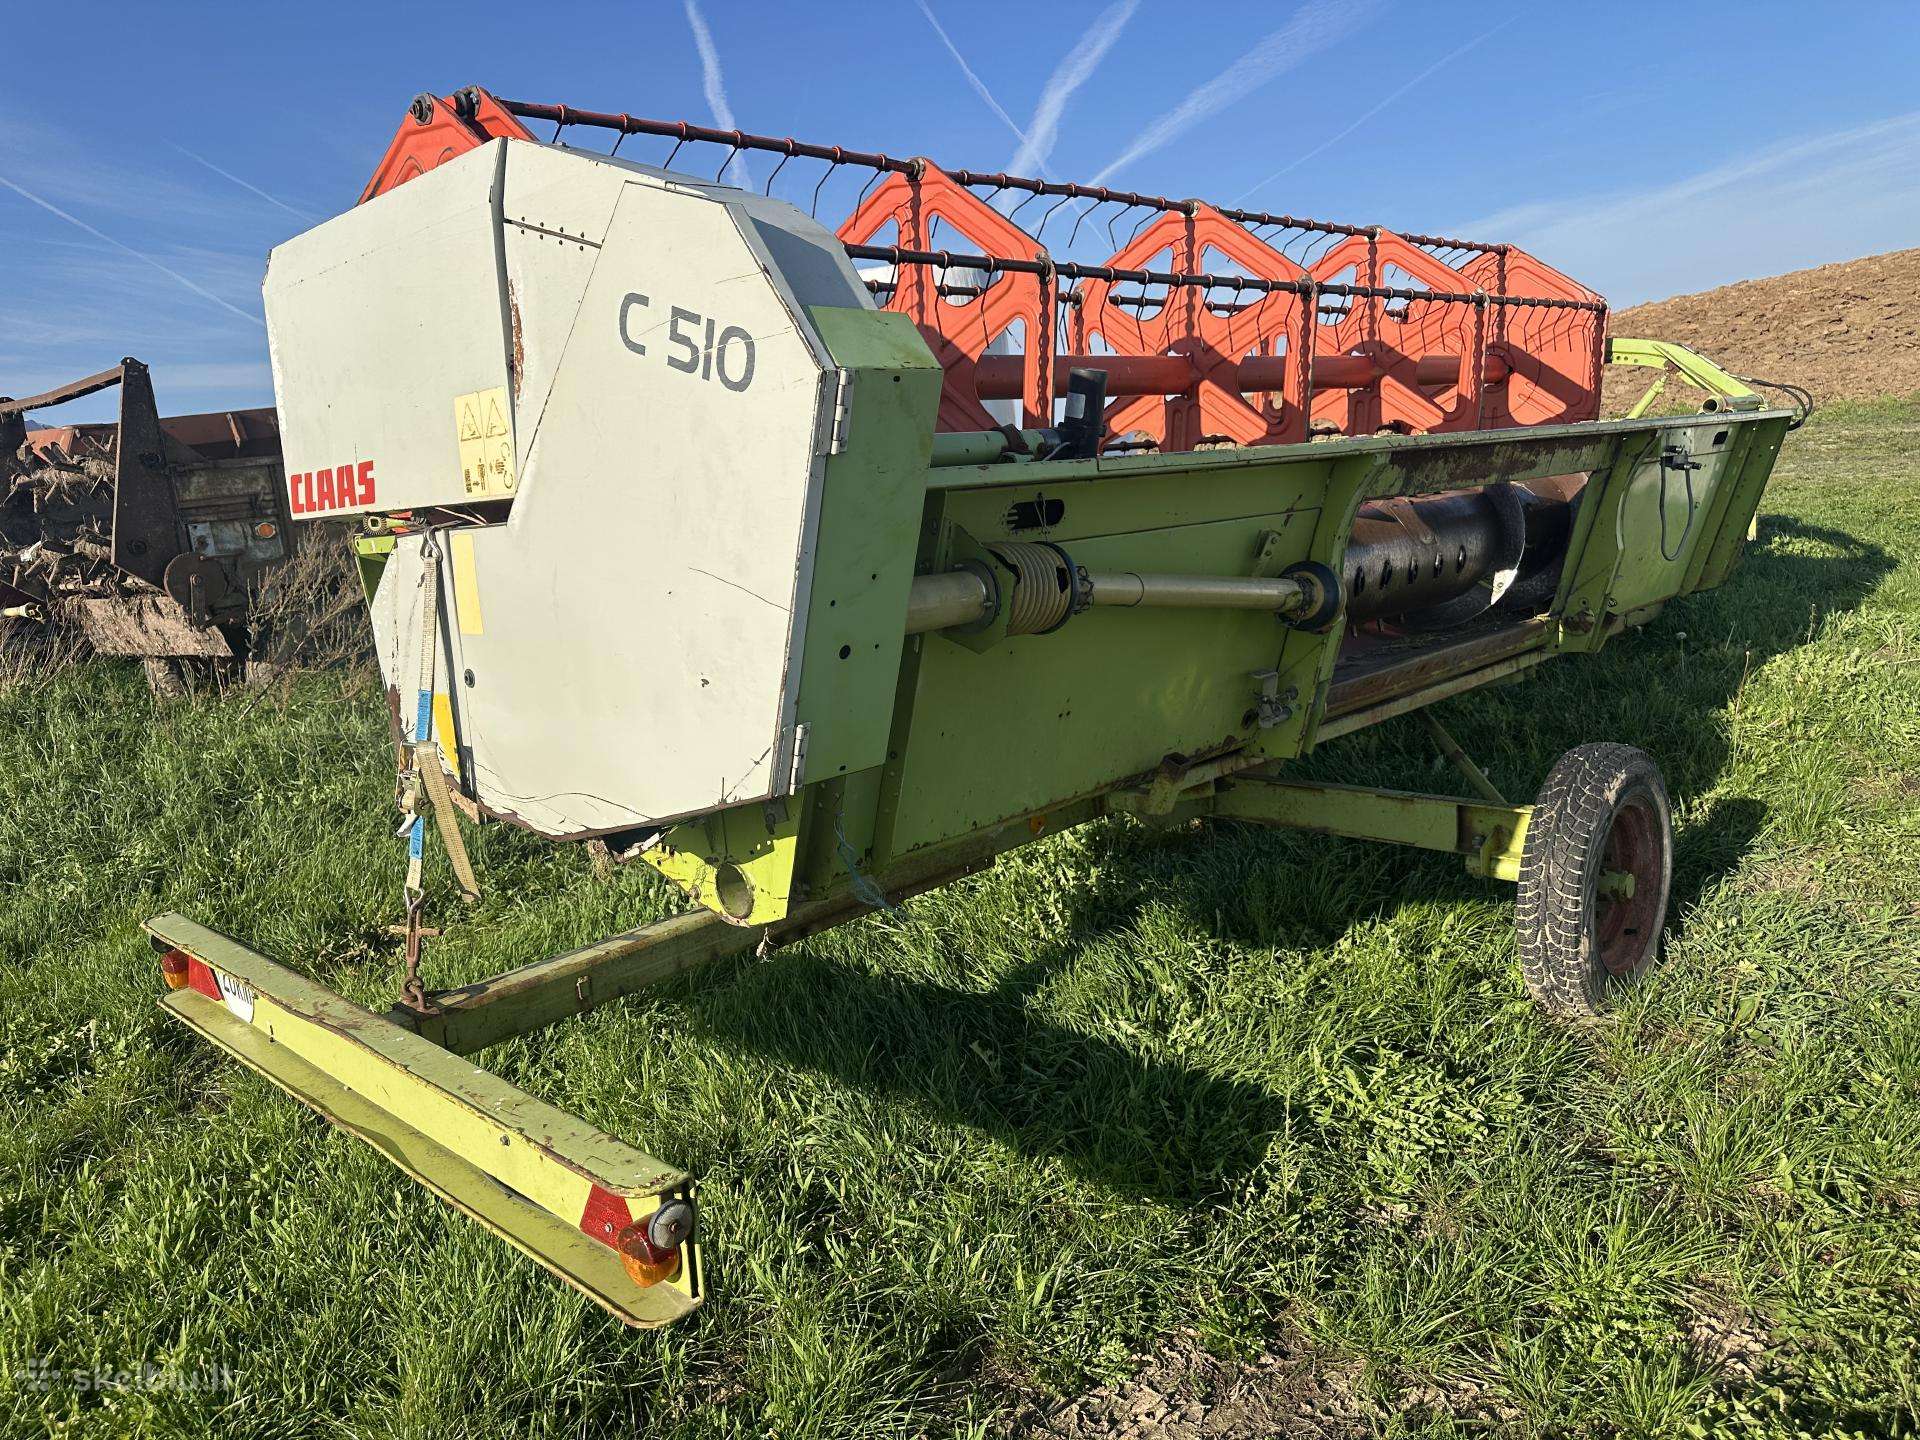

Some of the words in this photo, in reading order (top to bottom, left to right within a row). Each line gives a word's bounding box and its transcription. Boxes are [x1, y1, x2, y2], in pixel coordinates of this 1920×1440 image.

[619, 292, 649, 356] C
[667, 305, 755, 392] 510
[290, 460, 376, 514] CLAAS
